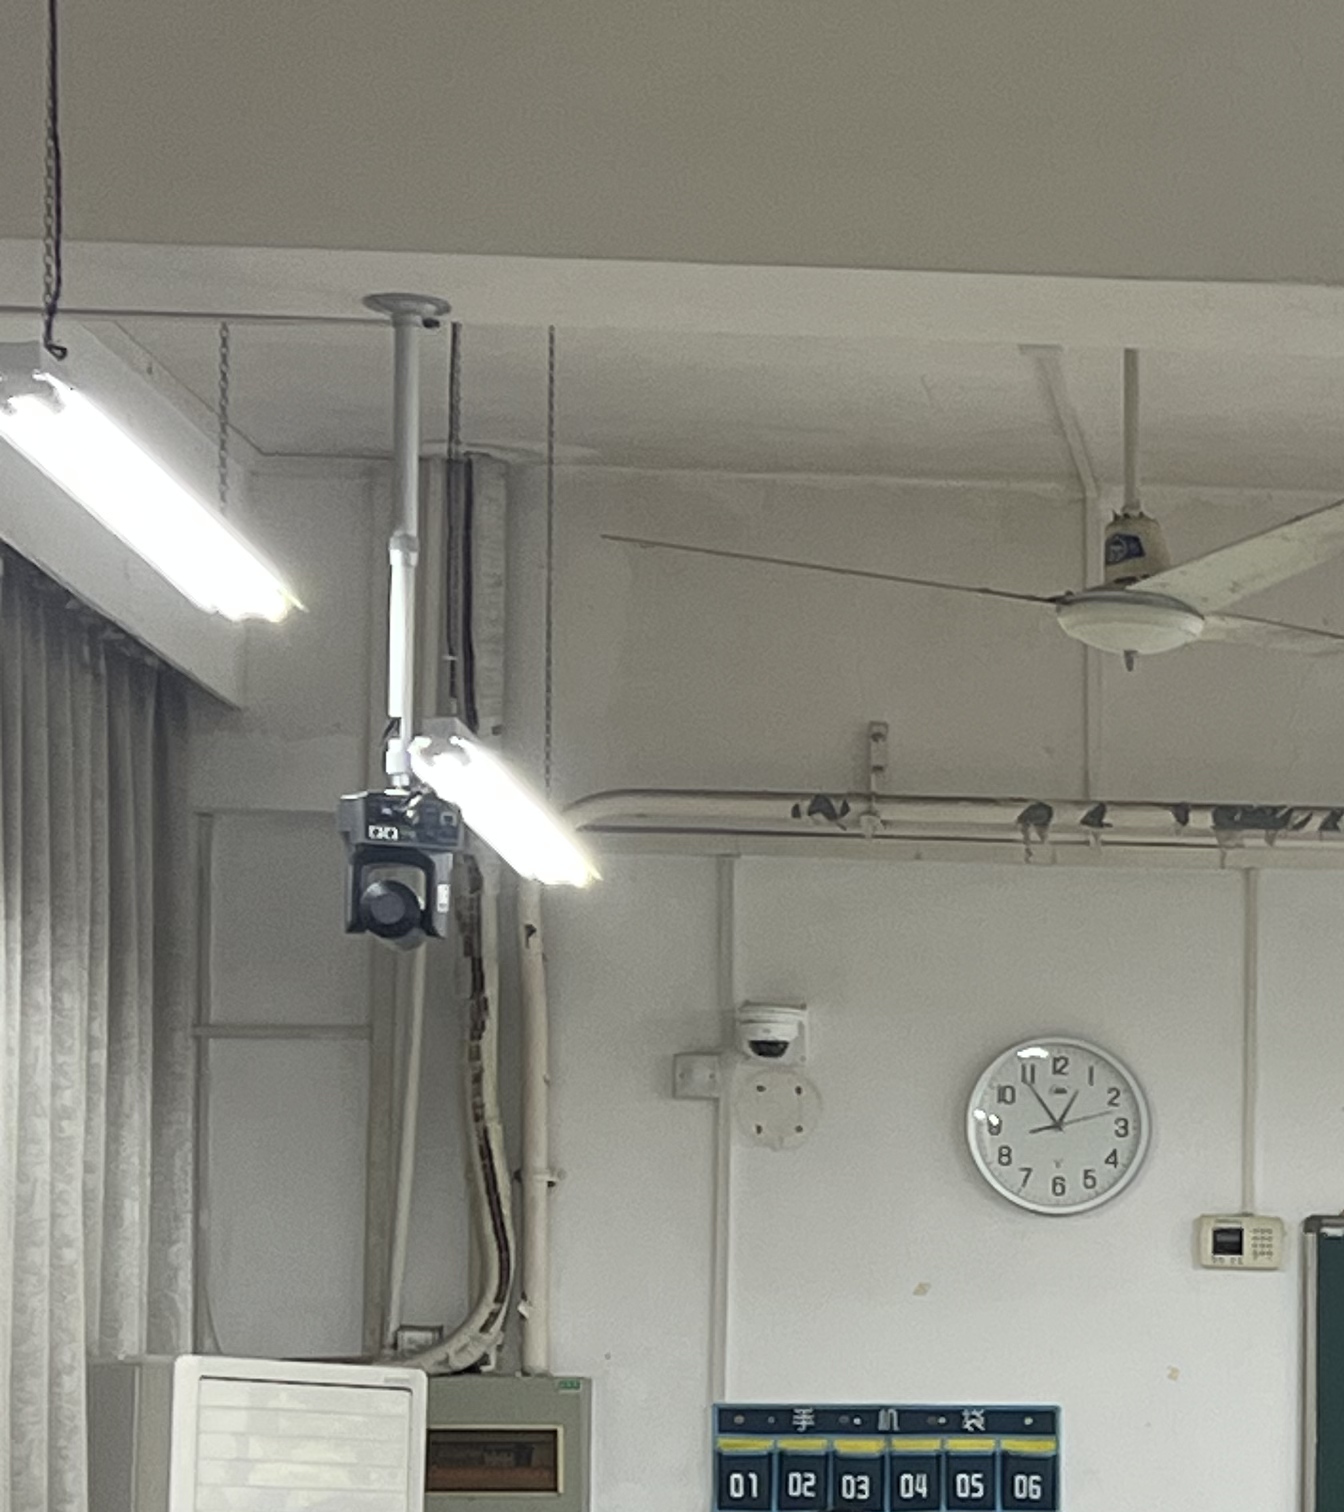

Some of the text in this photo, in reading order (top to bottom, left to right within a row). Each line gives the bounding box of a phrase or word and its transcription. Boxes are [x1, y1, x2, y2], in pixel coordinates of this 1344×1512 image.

[1020, 1063, 1036, 1085] 11
[1051, 1056, 1069, 1076] 12
[1087, 1065, 1095, 1087] 1
[996, 1085, 1016, 1106] 10
[1107, 1086, 1121, 1108] 2
[1114, 1117, 1129, 1138] 3
[998, 1145, 1013, 1167] 8
[1104, 1147, 1119, 1169] 4
[1018, 1167, 1033, 1188] 7
[1051, 1175, 1066, 1197] 6
[1083, 1168, 1097, 1190] 5
[730, 1472, 758, 1498] 01
[788, 1472, 816, 1498] 02
[841, 1475, 870, 1500] 03
[900, 1473, 928, 1498] 04
[956, 1473, 984, 1498] 05
[1014, 1474, 1042, 1500] 06
